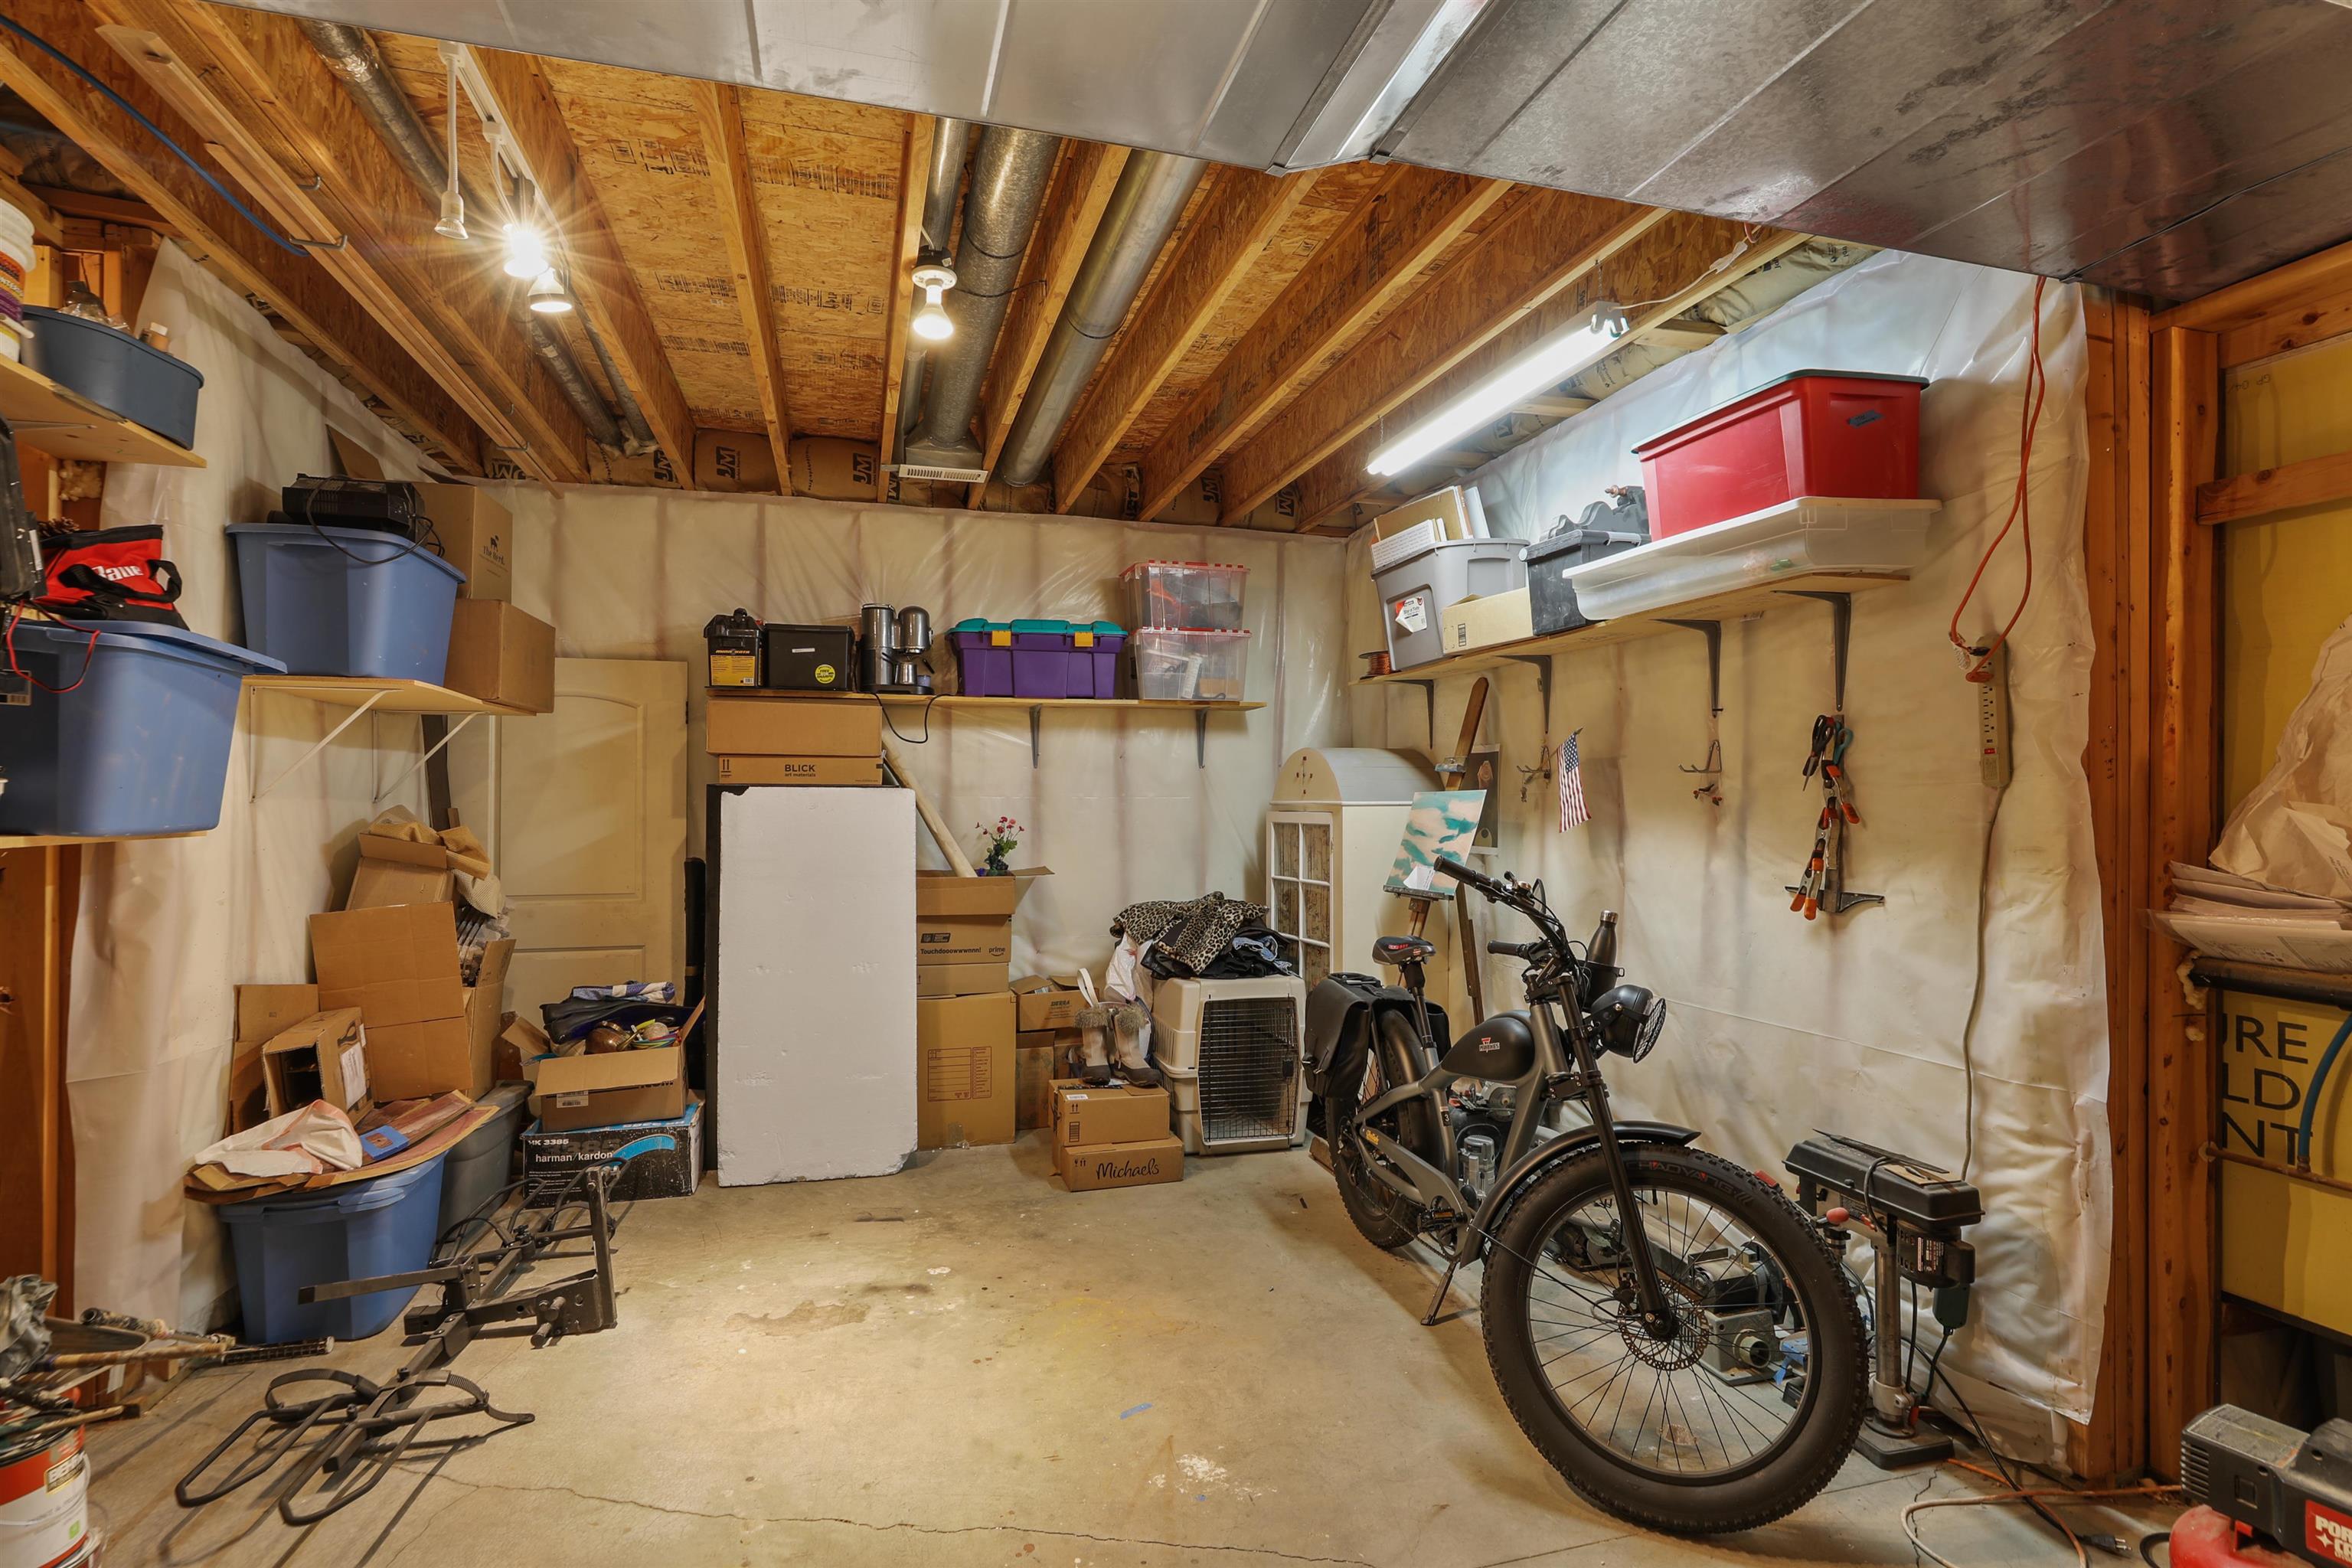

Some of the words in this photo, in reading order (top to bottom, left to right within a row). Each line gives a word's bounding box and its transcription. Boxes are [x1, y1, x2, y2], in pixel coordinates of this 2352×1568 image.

[716, 446, 736, 479] JM
[853, 452, 871, 485] JM
[784, 764, 815, 773] BLICK
[2222, 1013, 2308, 1064] RE
[1096, 1158, 1160, 1180] Michaels
